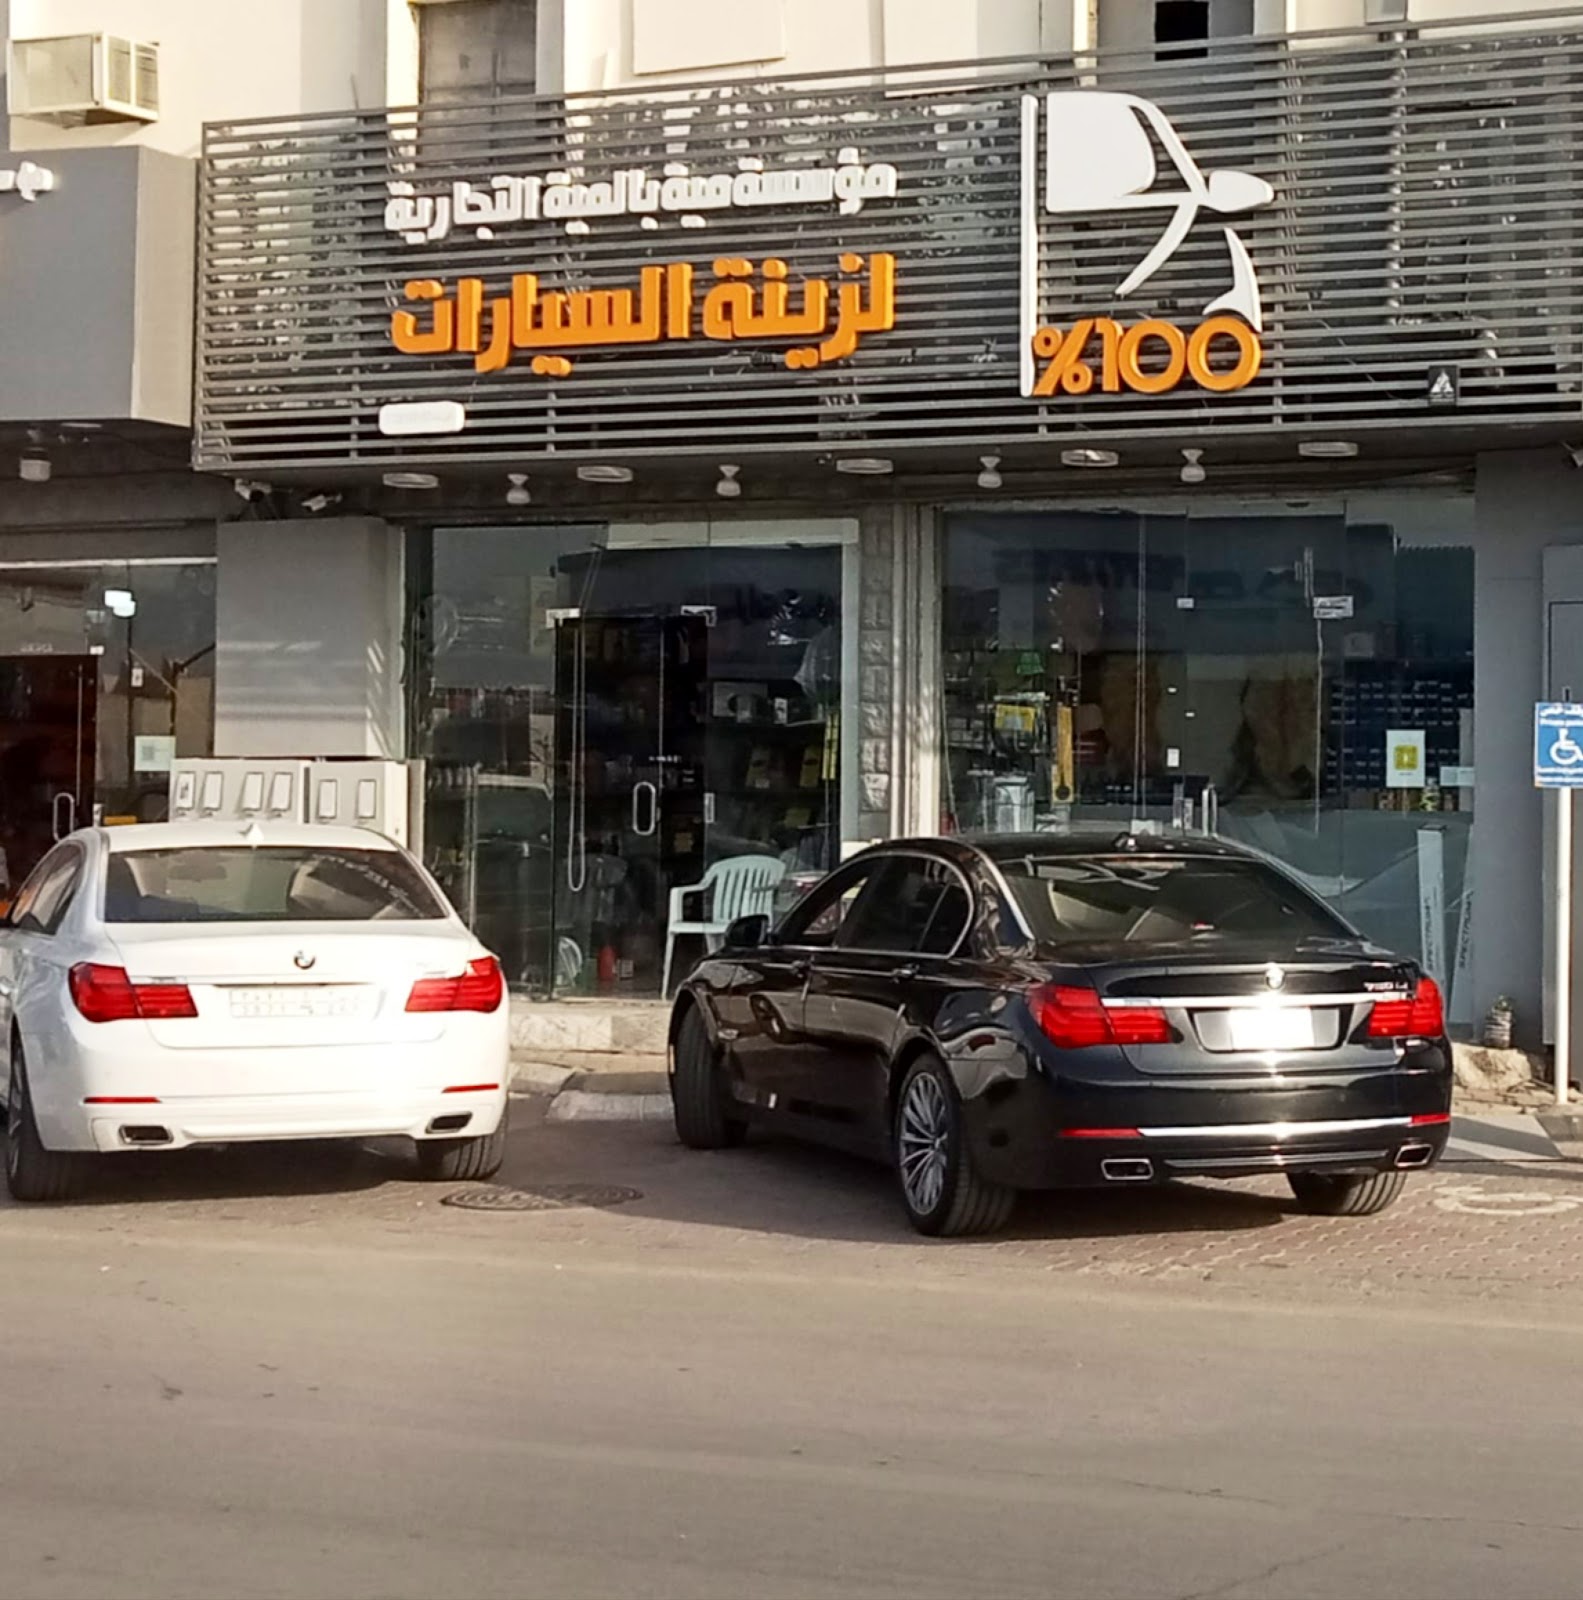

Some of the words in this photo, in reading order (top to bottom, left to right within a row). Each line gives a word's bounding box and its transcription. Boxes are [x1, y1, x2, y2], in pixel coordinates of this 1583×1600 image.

[384, 175, 542, 245] التجارية
[733, 147, 898, 215] مؤسسة
[390, 262, 692, 376] السيارات
[702, 252, 894, 369] لزينة
[1032, 315, 1263, 396] %100
